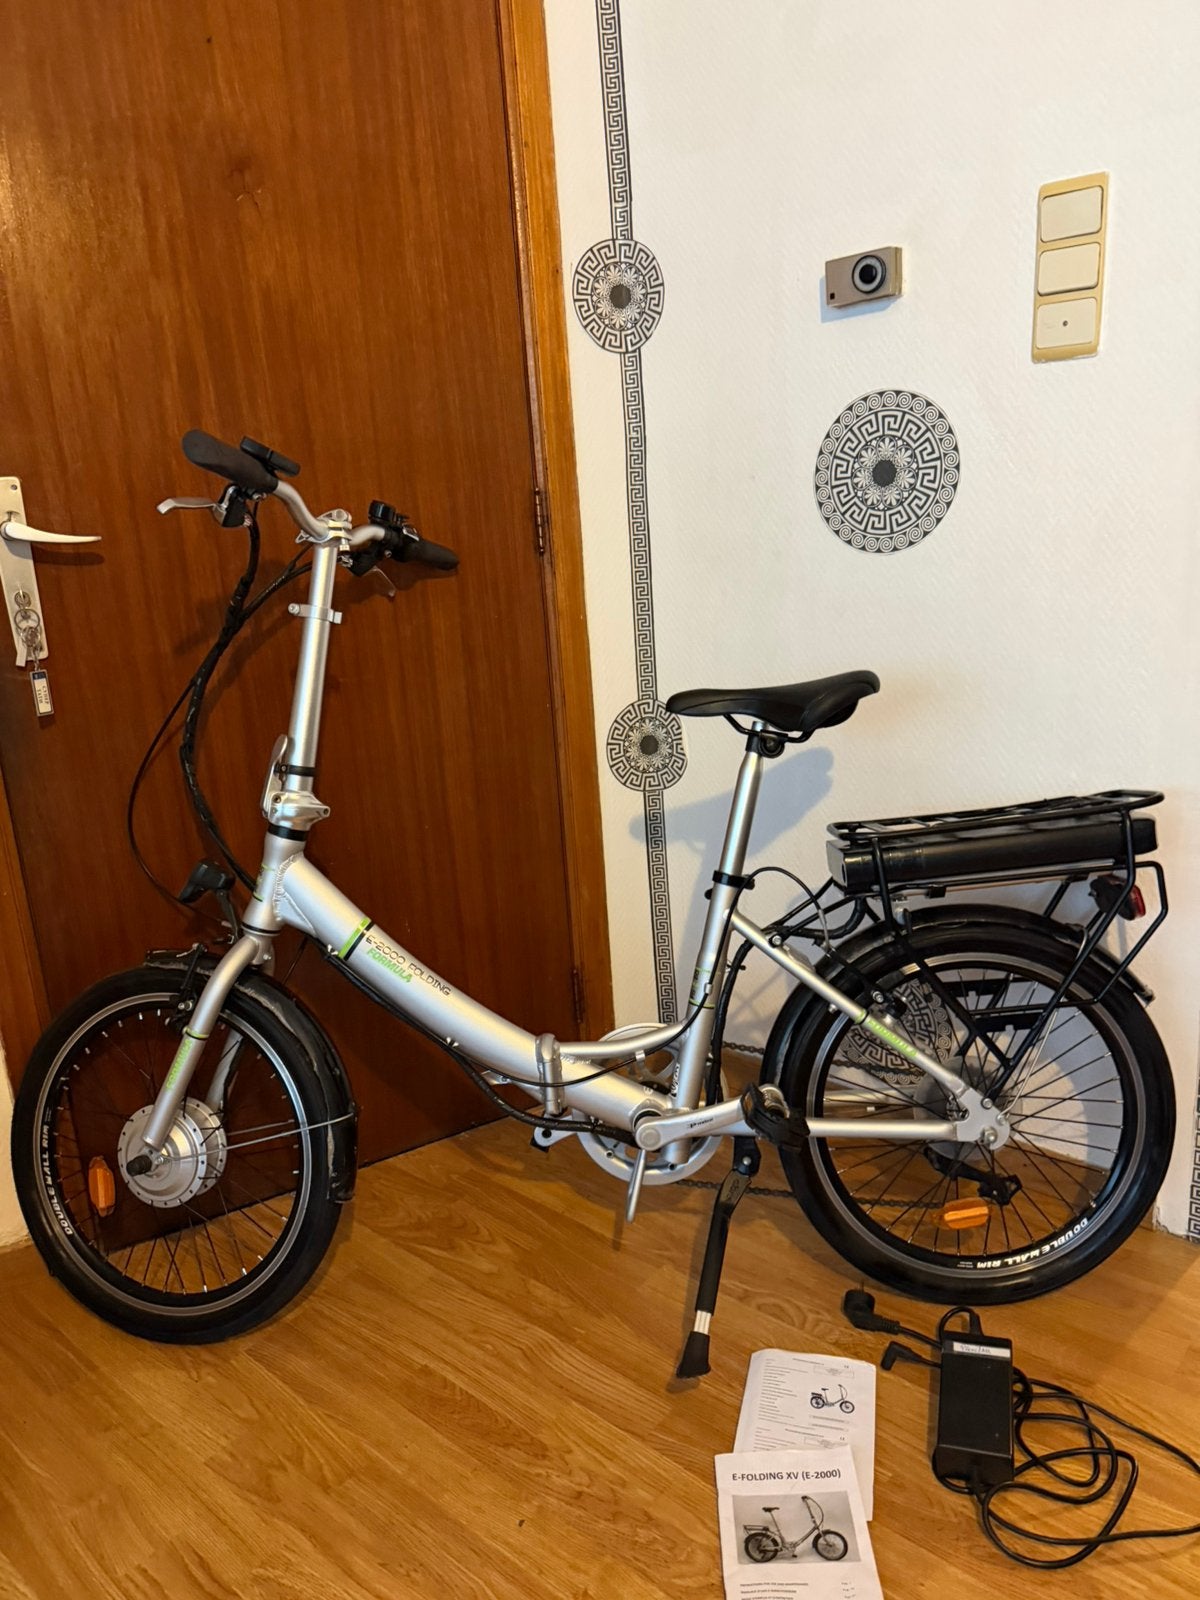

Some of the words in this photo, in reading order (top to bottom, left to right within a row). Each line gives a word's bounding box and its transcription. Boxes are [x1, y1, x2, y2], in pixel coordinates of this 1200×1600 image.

[365, 934, 406, 965] E-2000
[408, 962, 452, 997] FOLDING
[367, 947, 414, 984] FORMULA
[41, 1124, 50, 1148] RIM
[42, 1151, 53, 1186] WALL
[47, 1186, 74, 1236] DOUBLE
[1041, 1217, 1089, 1255] DOUBLE
[976, 1260, 1002, 1269] RIM
[1004, 1250, 1041, 1269] WALL
[732, 1471, 784, 1482] E-FOLDING
[786, 1471, 799, 1480] XV
[801, 1468, 842, 1481] (E-2000)
